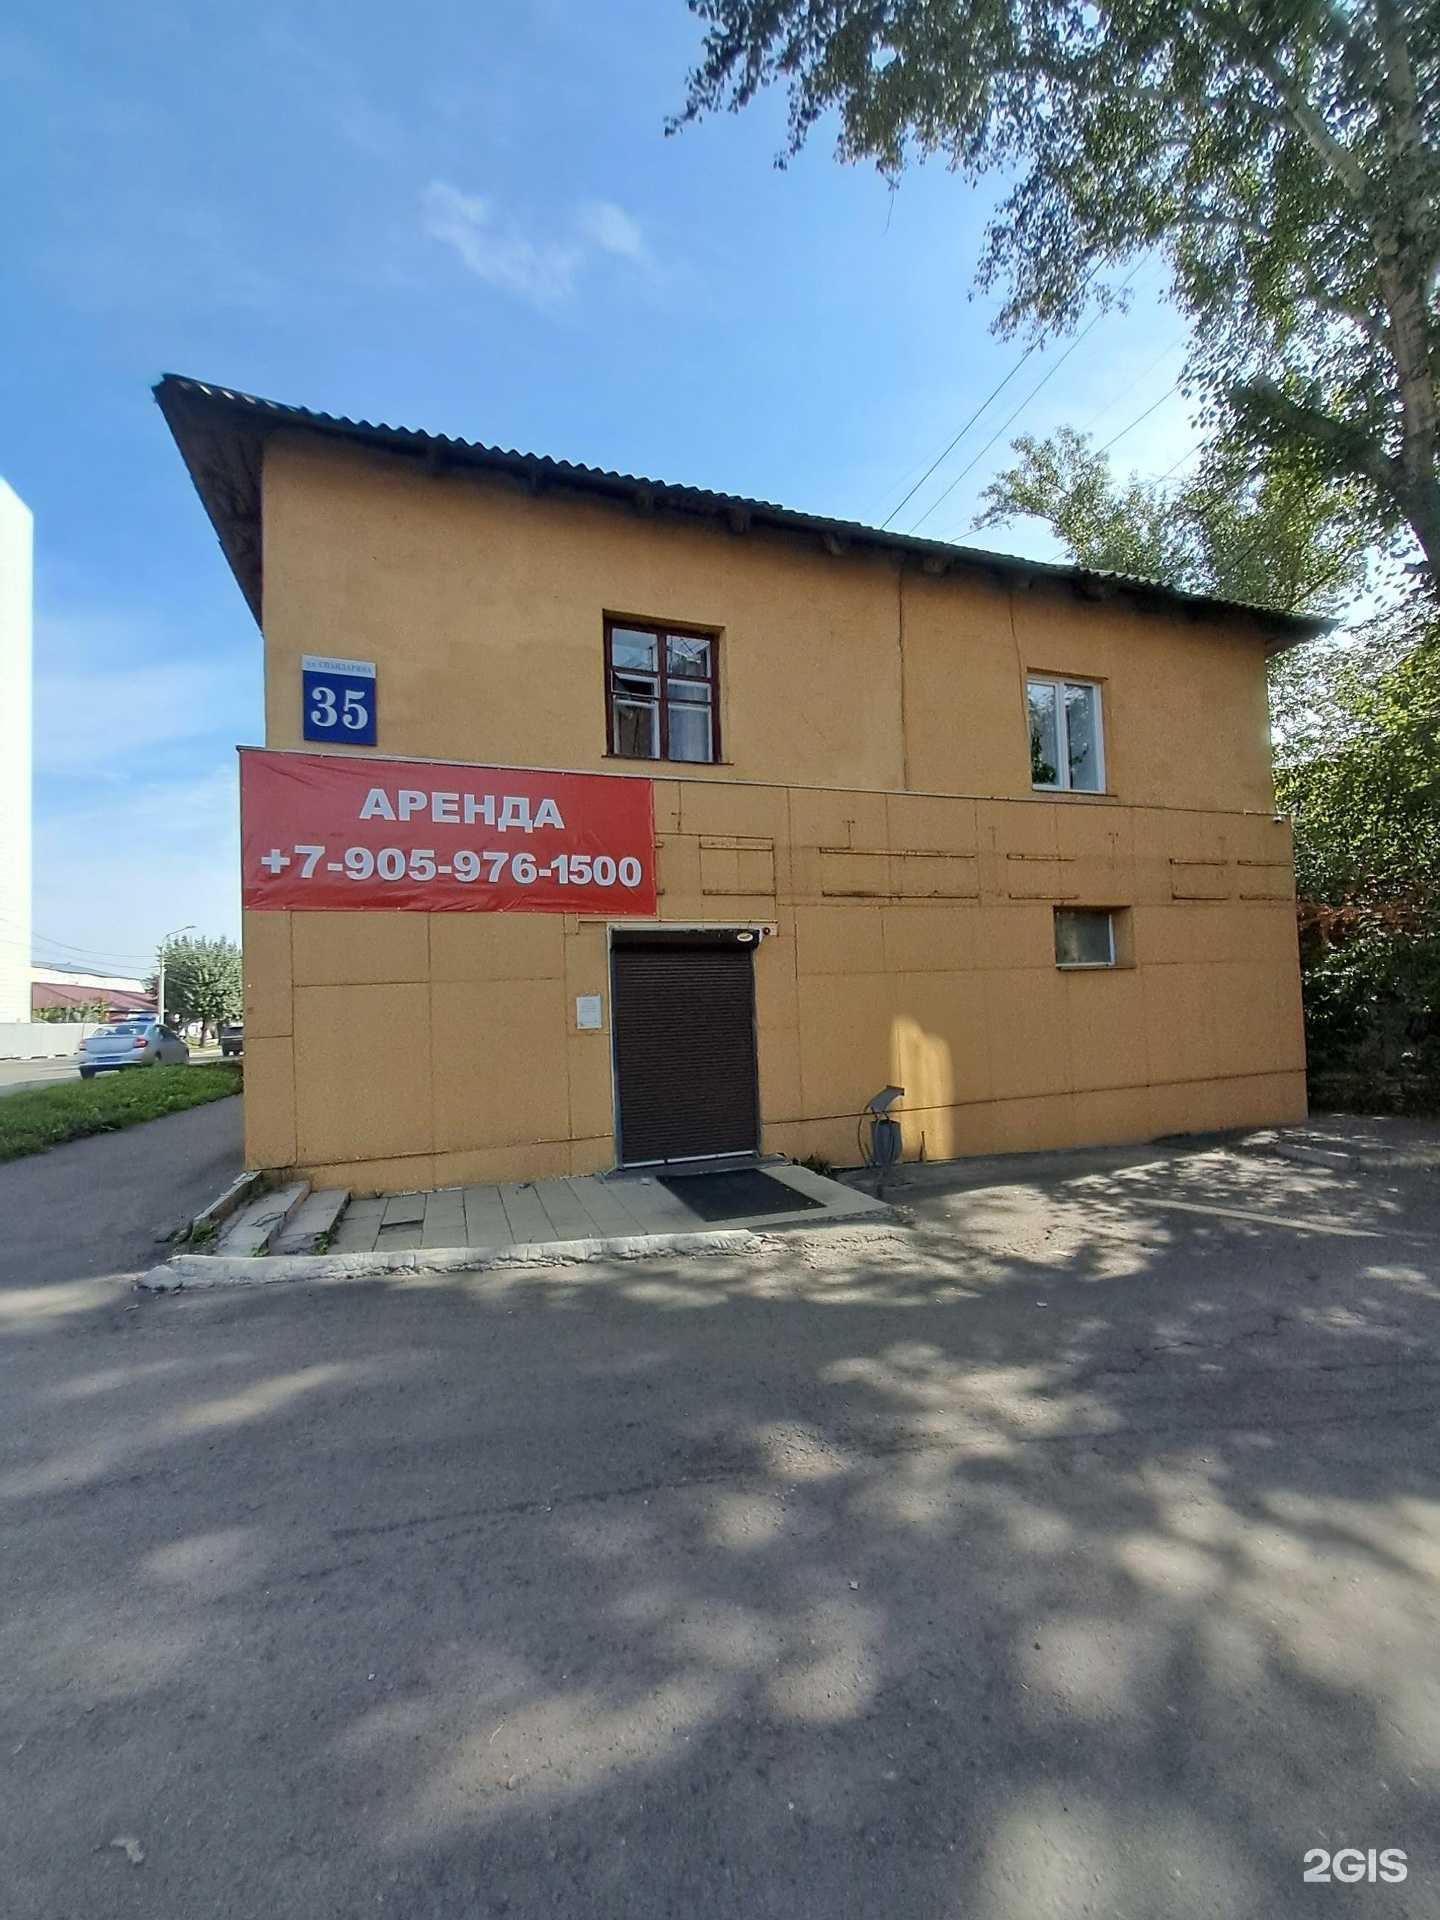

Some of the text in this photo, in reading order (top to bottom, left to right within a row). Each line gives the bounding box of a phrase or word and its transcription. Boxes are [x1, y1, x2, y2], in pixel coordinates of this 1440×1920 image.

[311, 687, 368, 730] 35
[359, 788, 566, 833] АРЕНДА
[261, 845, 642, 887] +7-905-976-1500
